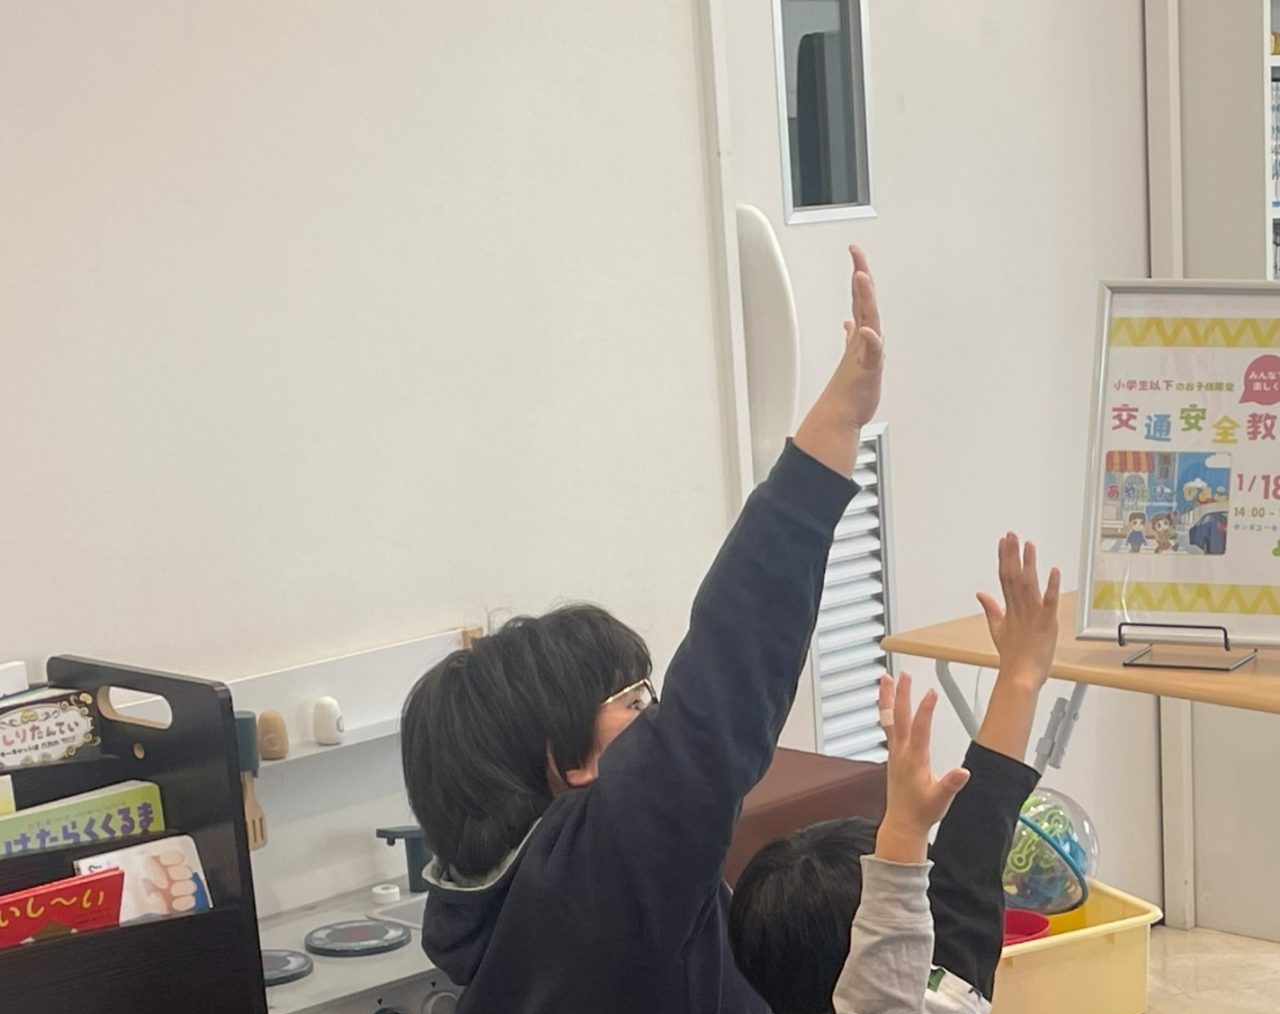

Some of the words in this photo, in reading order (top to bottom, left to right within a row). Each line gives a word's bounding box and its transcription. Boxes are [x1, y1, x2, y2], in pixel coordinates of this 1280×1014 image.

[1252, 381, 1280, 392] 楽しく
[1234, 507, 1265, 518] 14:00
